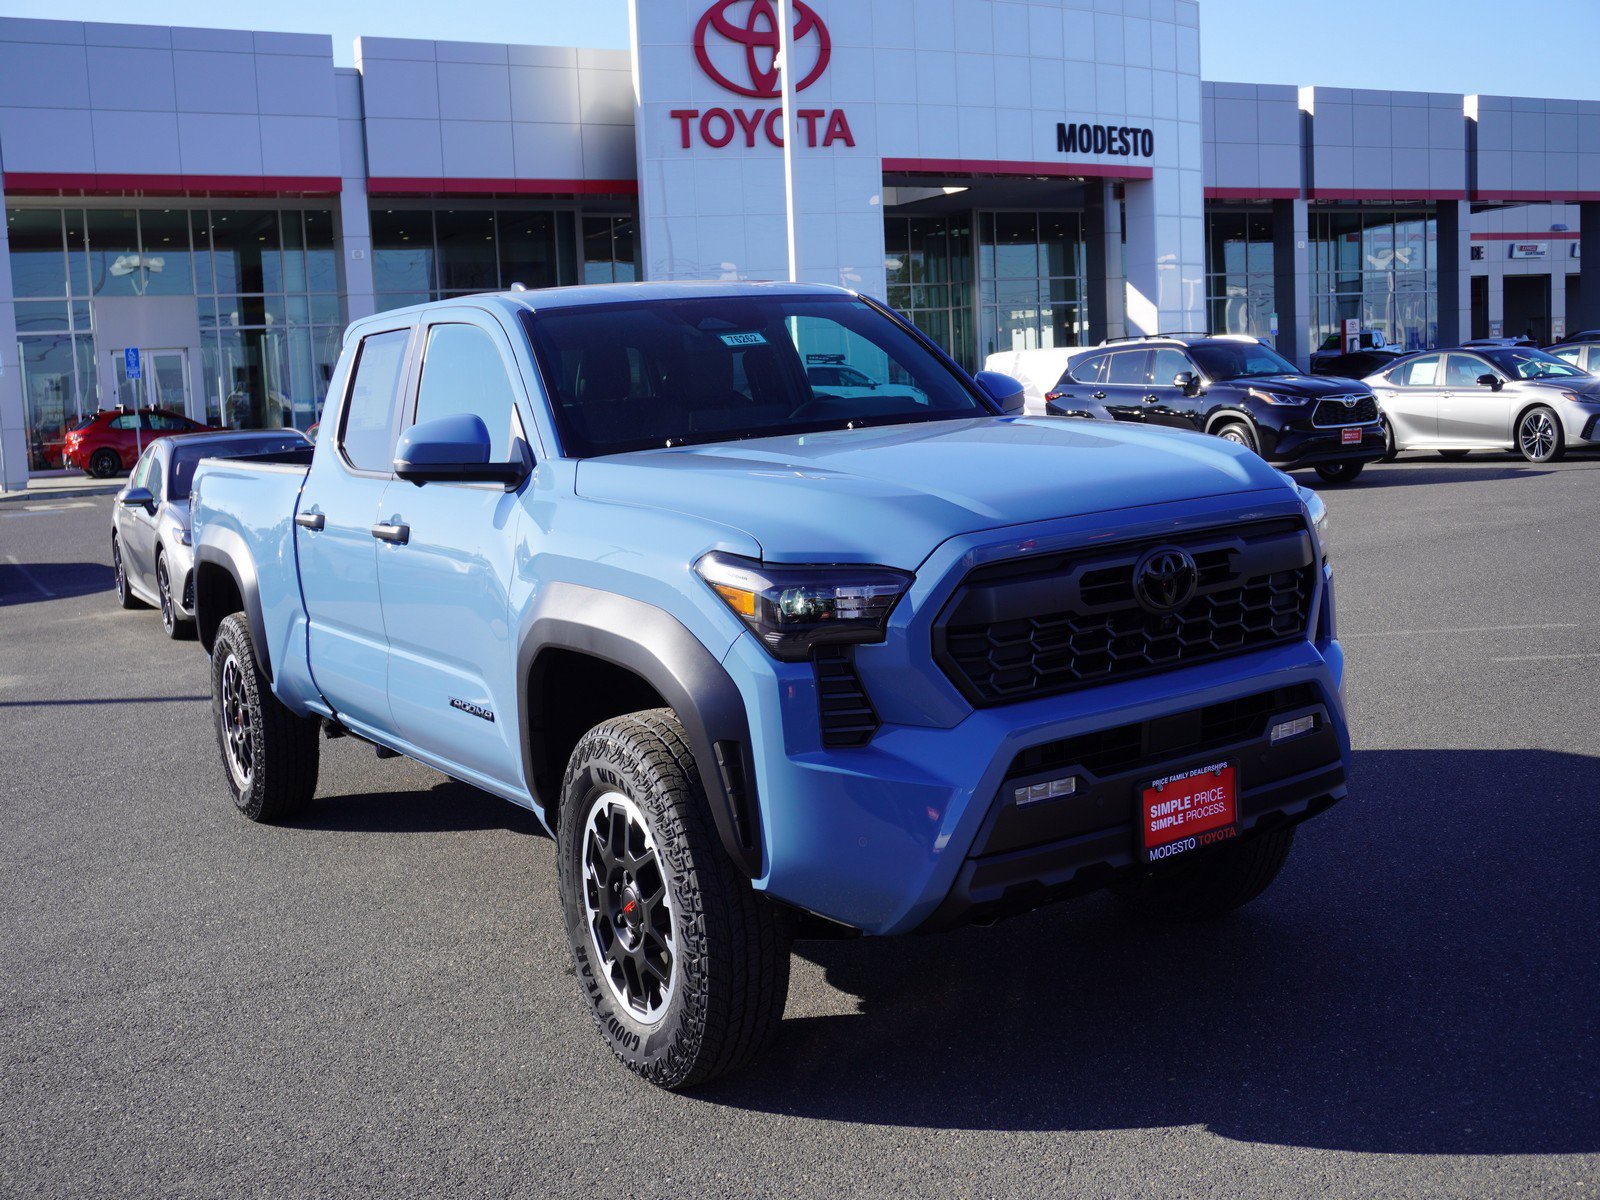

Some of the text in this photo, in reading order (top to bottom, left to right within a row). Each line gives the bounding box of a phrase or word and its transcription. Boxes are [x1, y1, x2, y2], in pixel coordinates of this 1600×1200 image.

[670, 107, 856, 148] TOYOTA
[1057, 123, 1154, 157] MODESTO
[727, 334, 760, 344] 76262
[1152, 761, 1228, 788] PRICE FAMILY DEALERSHIPS
[1150, 786, 1226, 819] SIMPLE PRICE.
[1151, 802, 1227, 832] SIMPLE PROCESS.
[1150, 827, 1237, 861] MODESTO TOYOTA
